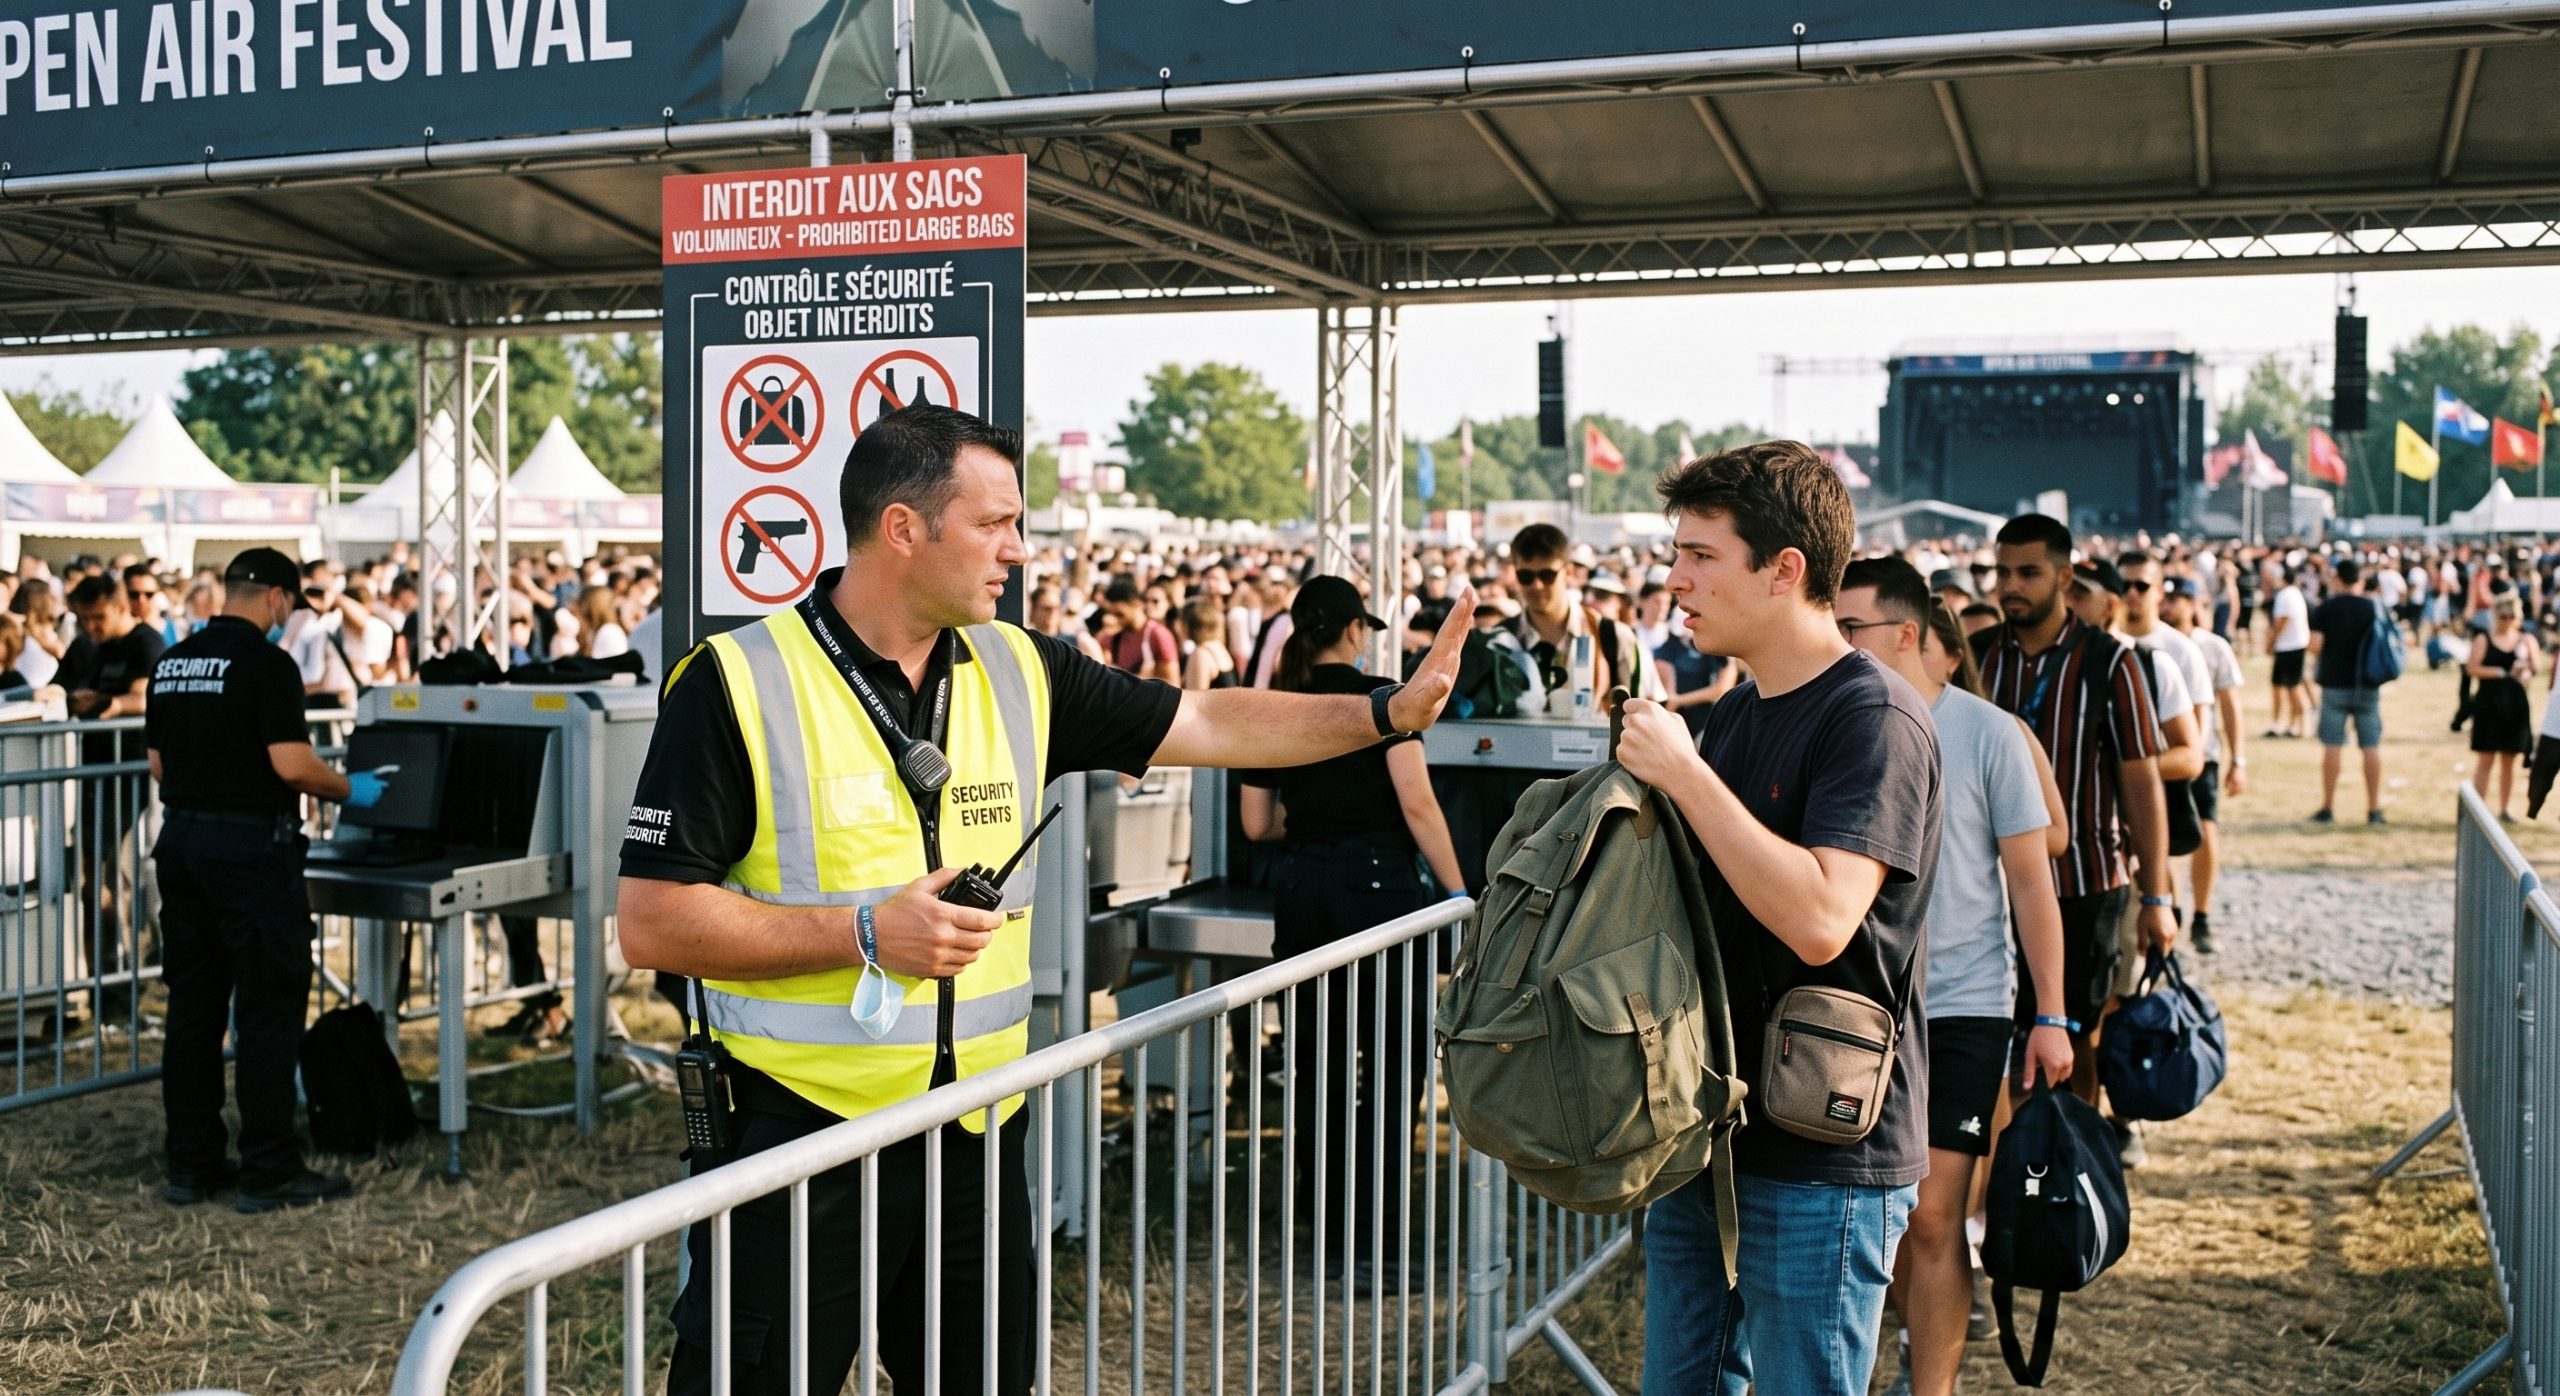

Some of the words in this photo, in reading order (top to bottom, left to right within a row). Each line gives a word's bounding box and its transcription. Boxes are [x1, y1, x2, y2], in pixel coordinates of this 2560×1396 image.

[141, 0, 256, 102] AIR
[703, 177, 831, 221] INTERDIT
[838, 172, 898, 214] AUX
[905, 167, 983, 210] SACS
[672, 225, 782, 254] VOLUMINEUX
[798, 219, 901, 247] PROHIBITED
[905, 215, 963, 242] LARGE
[966, 212, 1015, 239] BAGS
[725, 268, 840, 306] CONTRÔLE
[845, 261, 955, 301] SÉCURITÉ
[744, 309, 812, 339] OBJET
[817, 303, 934, 336] INTERDITS
[155, 658, 231, 679] SECURITY
[951, 781, 1013, 804] SECURITY
[961, 805, 1012, 827] EVENTS
